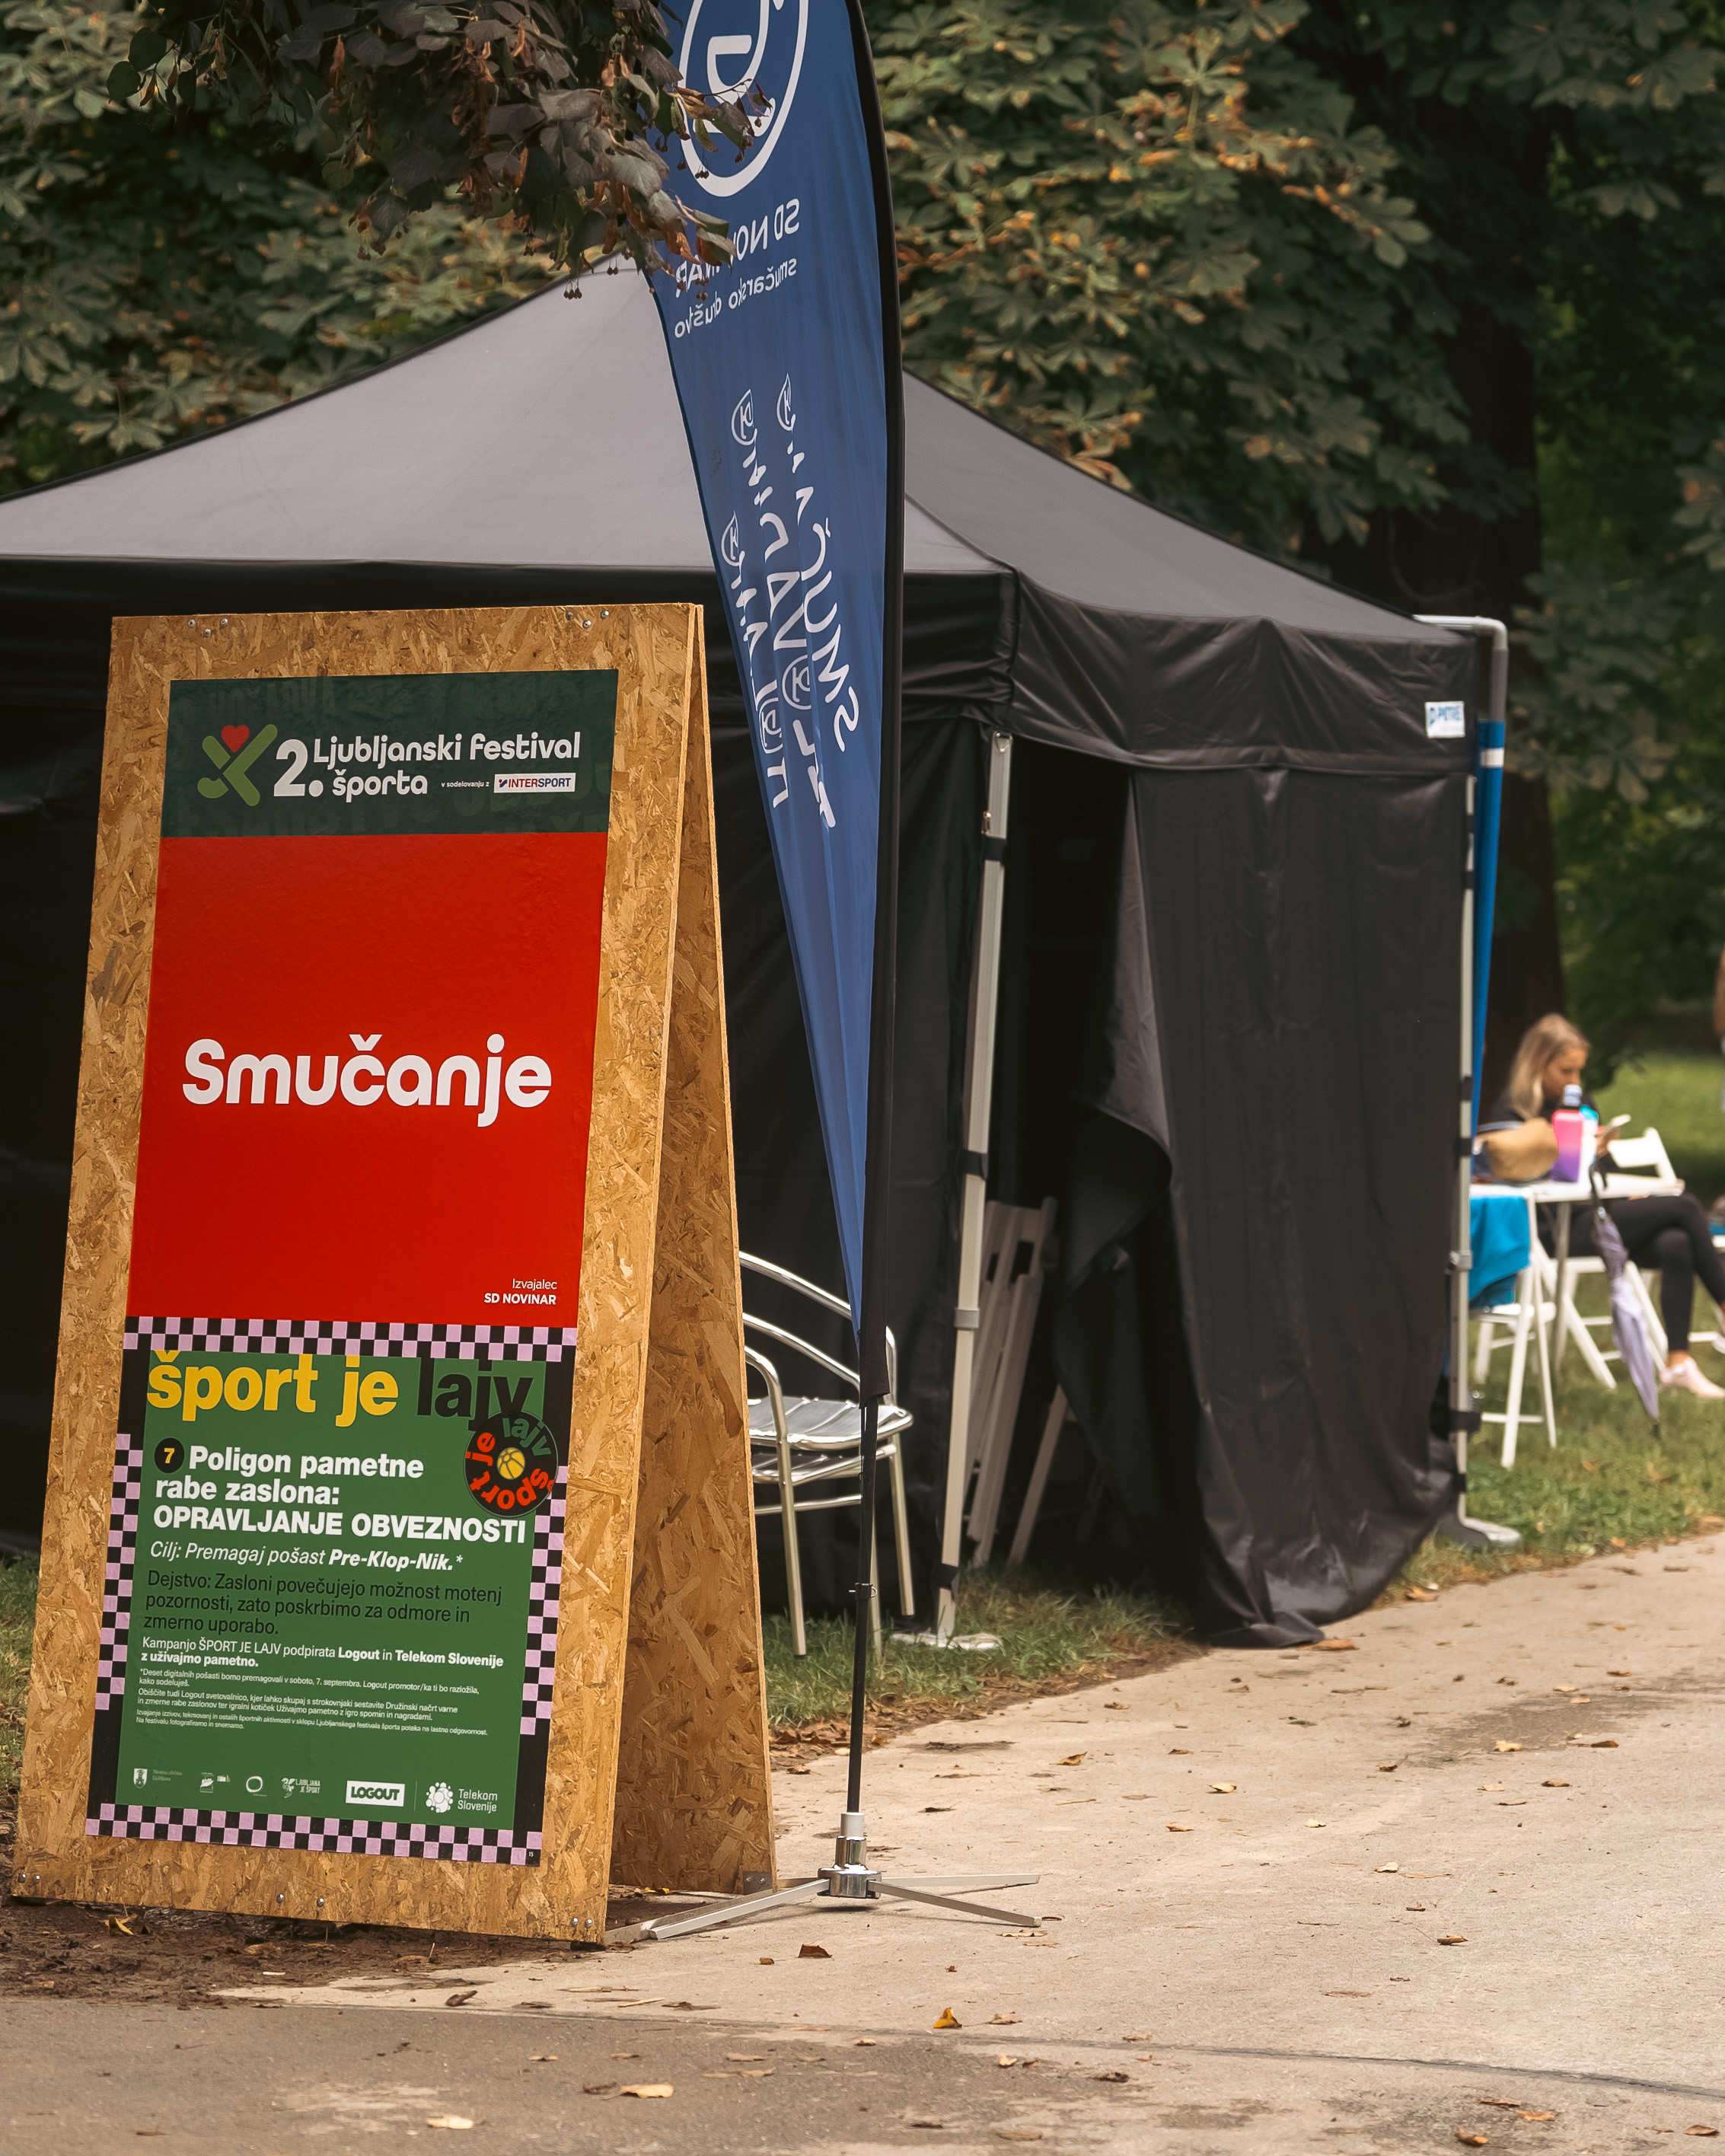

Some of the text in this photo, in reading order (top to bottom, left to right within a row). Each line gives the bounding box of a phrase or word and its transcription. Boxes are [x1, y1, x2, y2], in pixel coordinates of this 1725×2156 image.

[274, 732, 580, 797] 2. Ljubljanski festival
[332, 769, 427, 802] športa
[509, 778, 572, 788] INTERSPORT
[183, 1034, 552, 1127] Smučanje
[512, 1278, 557, 1290] Izvajalec
[484, 1293, 556, 1306] SD NOVINAR
[147, 1350, 534, 1431] šport je lajv
[465, 1432, 496, 1466] je
[502, 1418, 551, 1456] lajv
[164, 1446, 424, 1479] 7 Poligon pametne
[156, 1476, 340, 1506] rabe zaslona:
[154, 1505, 526, 1544] OPRAVLJANJE OBVEZNOSTI
[150, 1541, 181, 1562] Cilj:
[185, 1543, 265, 1566] Premagaj
[267, 1547, 325, 1567] pošast
[148, 1570, 502, 1606] Dejstvo: Zasloni povečujejo možnost motenj
[145, 1595, 470, 1623] pozornosti, zato poskrbimo za odmore in
[143, 1615, 279, 1637] zmerno uporabo.
[142, 1637, 503, 1669] Kampanjo ŠPORT JE LAJV podpirata Logout in Telekom Slovenije
[150, 1651, 202, 1666] uživajmo
[203, 1655, 259, 1667] pametno.
[164, 1670, 194, 1678] digitalnih
[196, 1671, 220, 1679] pošasti
[289, 1677, 314, 1686] soboto,
[363, 1680, 387, 1689] Logout
[138, 1688, 165, 1696] Obiščite
[181, 1691, 204, 1699] Logout
[250, 1694, 263, 1703] kjer
[283, 1696, 305, 1705] skupaj
[312, 1698, 352, 1708] strokovnjaki
[386, 1702, 418, 1711] Družinski
[419, 1704, 437, 1712] načrt
[229, 1702, 249, 1711] igralni
[250, 1703, 275, 1711] kotiček
[276, 1705, 307, 1714] Uživajmo
[345, 1709, 358, 1717] igro
[394, 1712, 432, 1721] nagradami.
[351, 1786, 400, 1800] LOGOUT
[458, 1789, 498, 1800] Telekom
[458, 1800, 497, 1814] Slovenije
